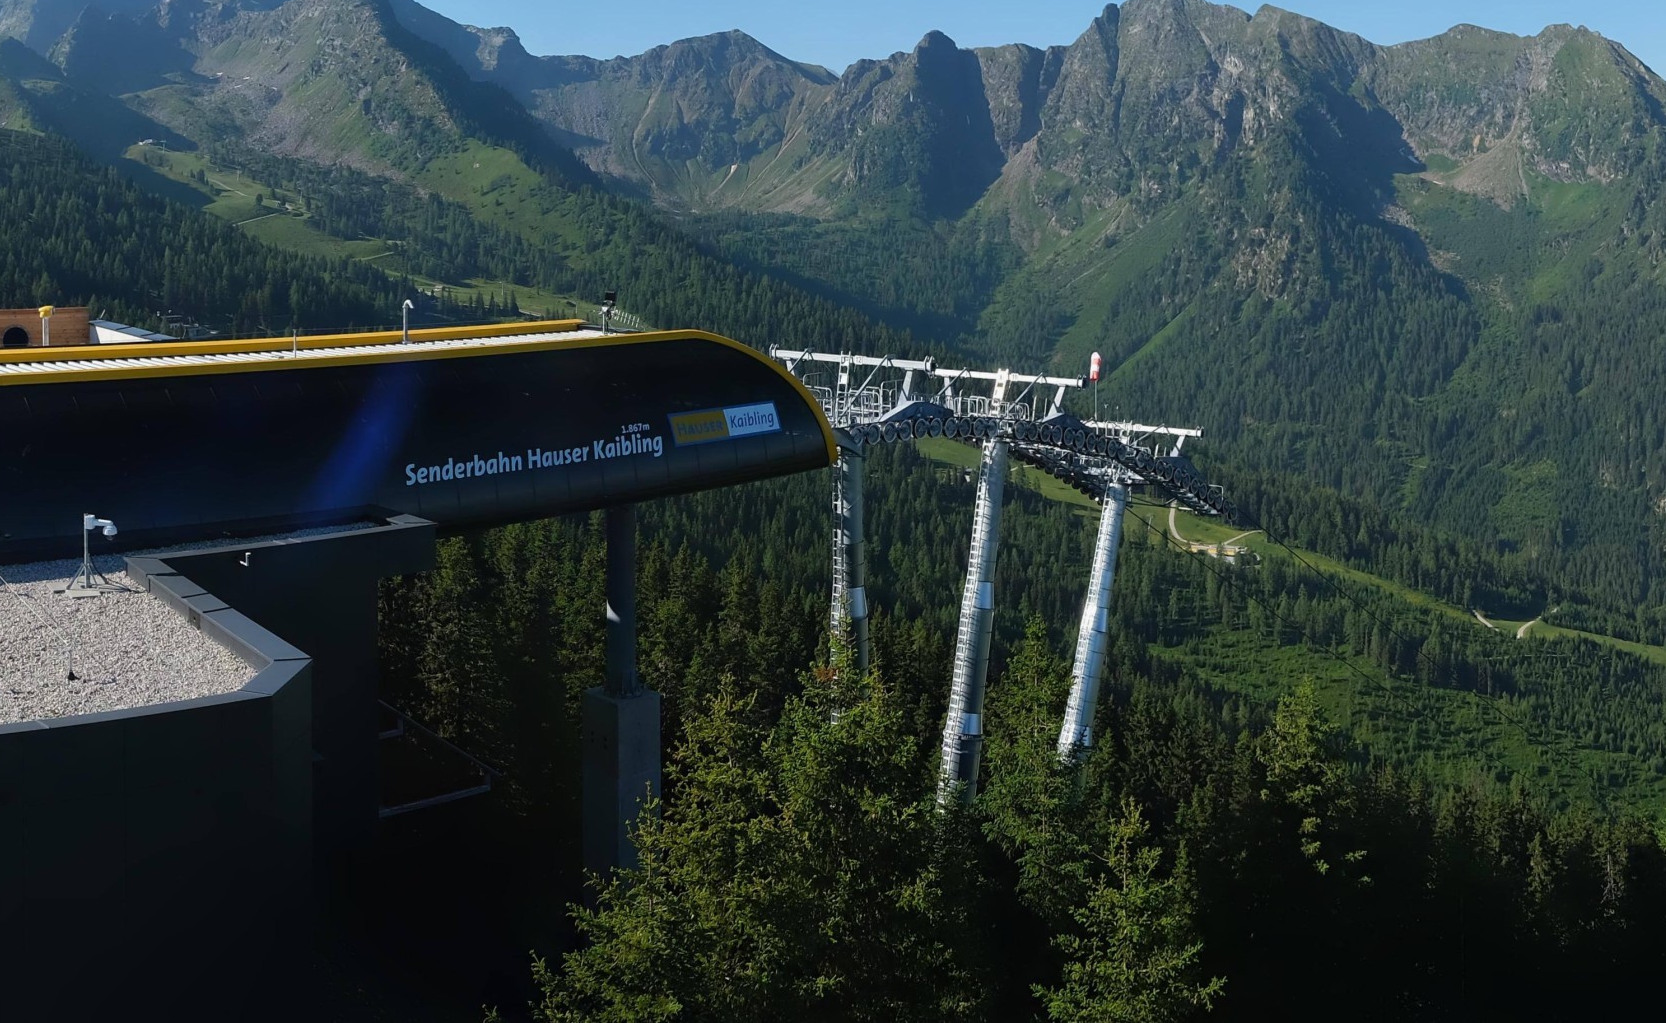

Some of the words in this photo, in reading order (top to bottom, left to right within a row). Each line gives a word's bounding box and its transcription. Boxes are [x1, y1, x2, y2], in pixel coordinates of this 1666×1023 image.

[621, 422, 650, 434] 1.867m
[676, 419, 723, 437] HAUSER
[730, 411, 775, 429] Kaibling
[405, 452, 523, 486] Senderbahn
[528, 445, 590, 470] Hauser
[593, 434, 663, 460] Kaibling
